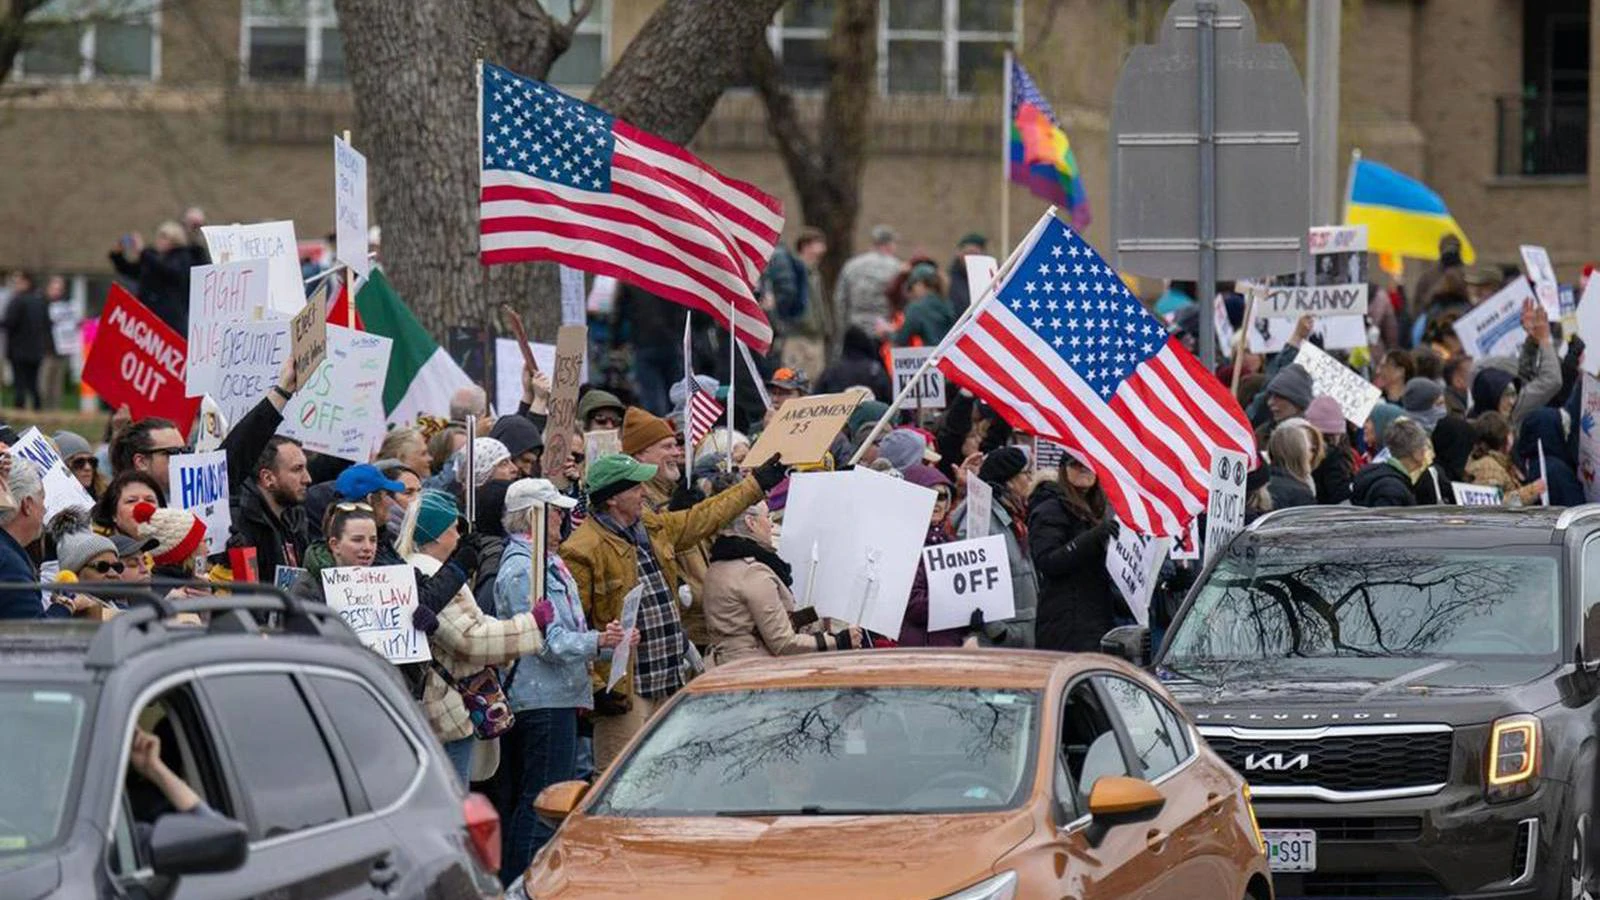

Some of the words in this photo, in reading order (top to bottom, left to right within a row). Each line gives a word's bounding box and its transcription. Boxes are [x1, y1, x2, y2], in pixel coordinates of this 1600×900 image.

[204, 269, 253, 319] FIGHT
[1265, 289, 1360, 312] TYRANNY
[221, 328, 286, 369] EXECUTIVE
[121, 351, 167, 402] OUT
[779, 404, 854, 422] AMENDMENT
[789, 421, 811, 434] 25
[953, 566, 999, 595] OFF
[379, 585, 412, 606] LAW
[1245, 753, 1310, 771] KIA
